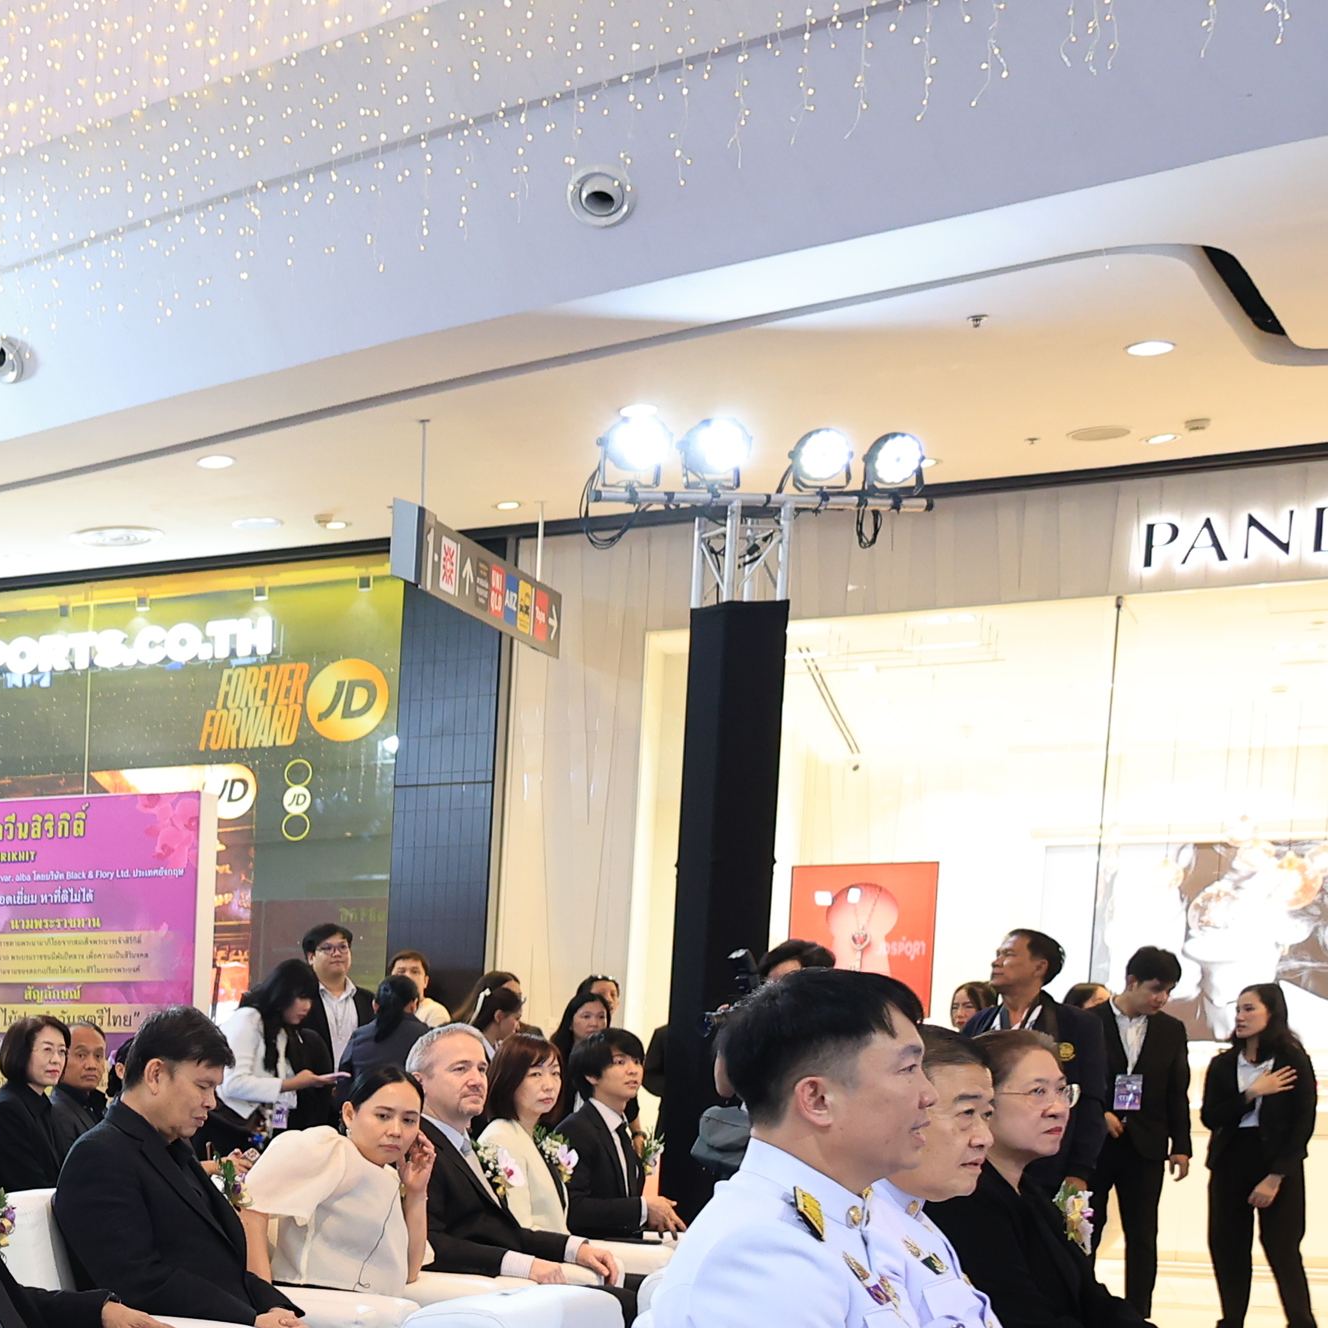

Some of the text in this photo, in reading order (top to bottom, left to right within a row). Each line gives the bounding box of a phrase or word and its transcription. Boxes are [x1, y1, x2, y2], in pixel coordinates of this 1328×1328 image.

[491, 569, 503, 591] UNI
[216, 662, 309, 709] FOREVER
[317, 679, 377, 722] JD
[199, 703, 302, 751] FORWARD
[288, 793, 307, 807] JD
[15, 873, 31, 882] alba
[66, 869, 86, 880] Black
[88, 870, 95, 880] &
[96, 869, 114, 881] Flory
[116, 868, 131, 879] Ltd.
[10, 916, 102, 931] นามพระราชทาน
[24, 984, 82, 1004] สัญลักษณ์
